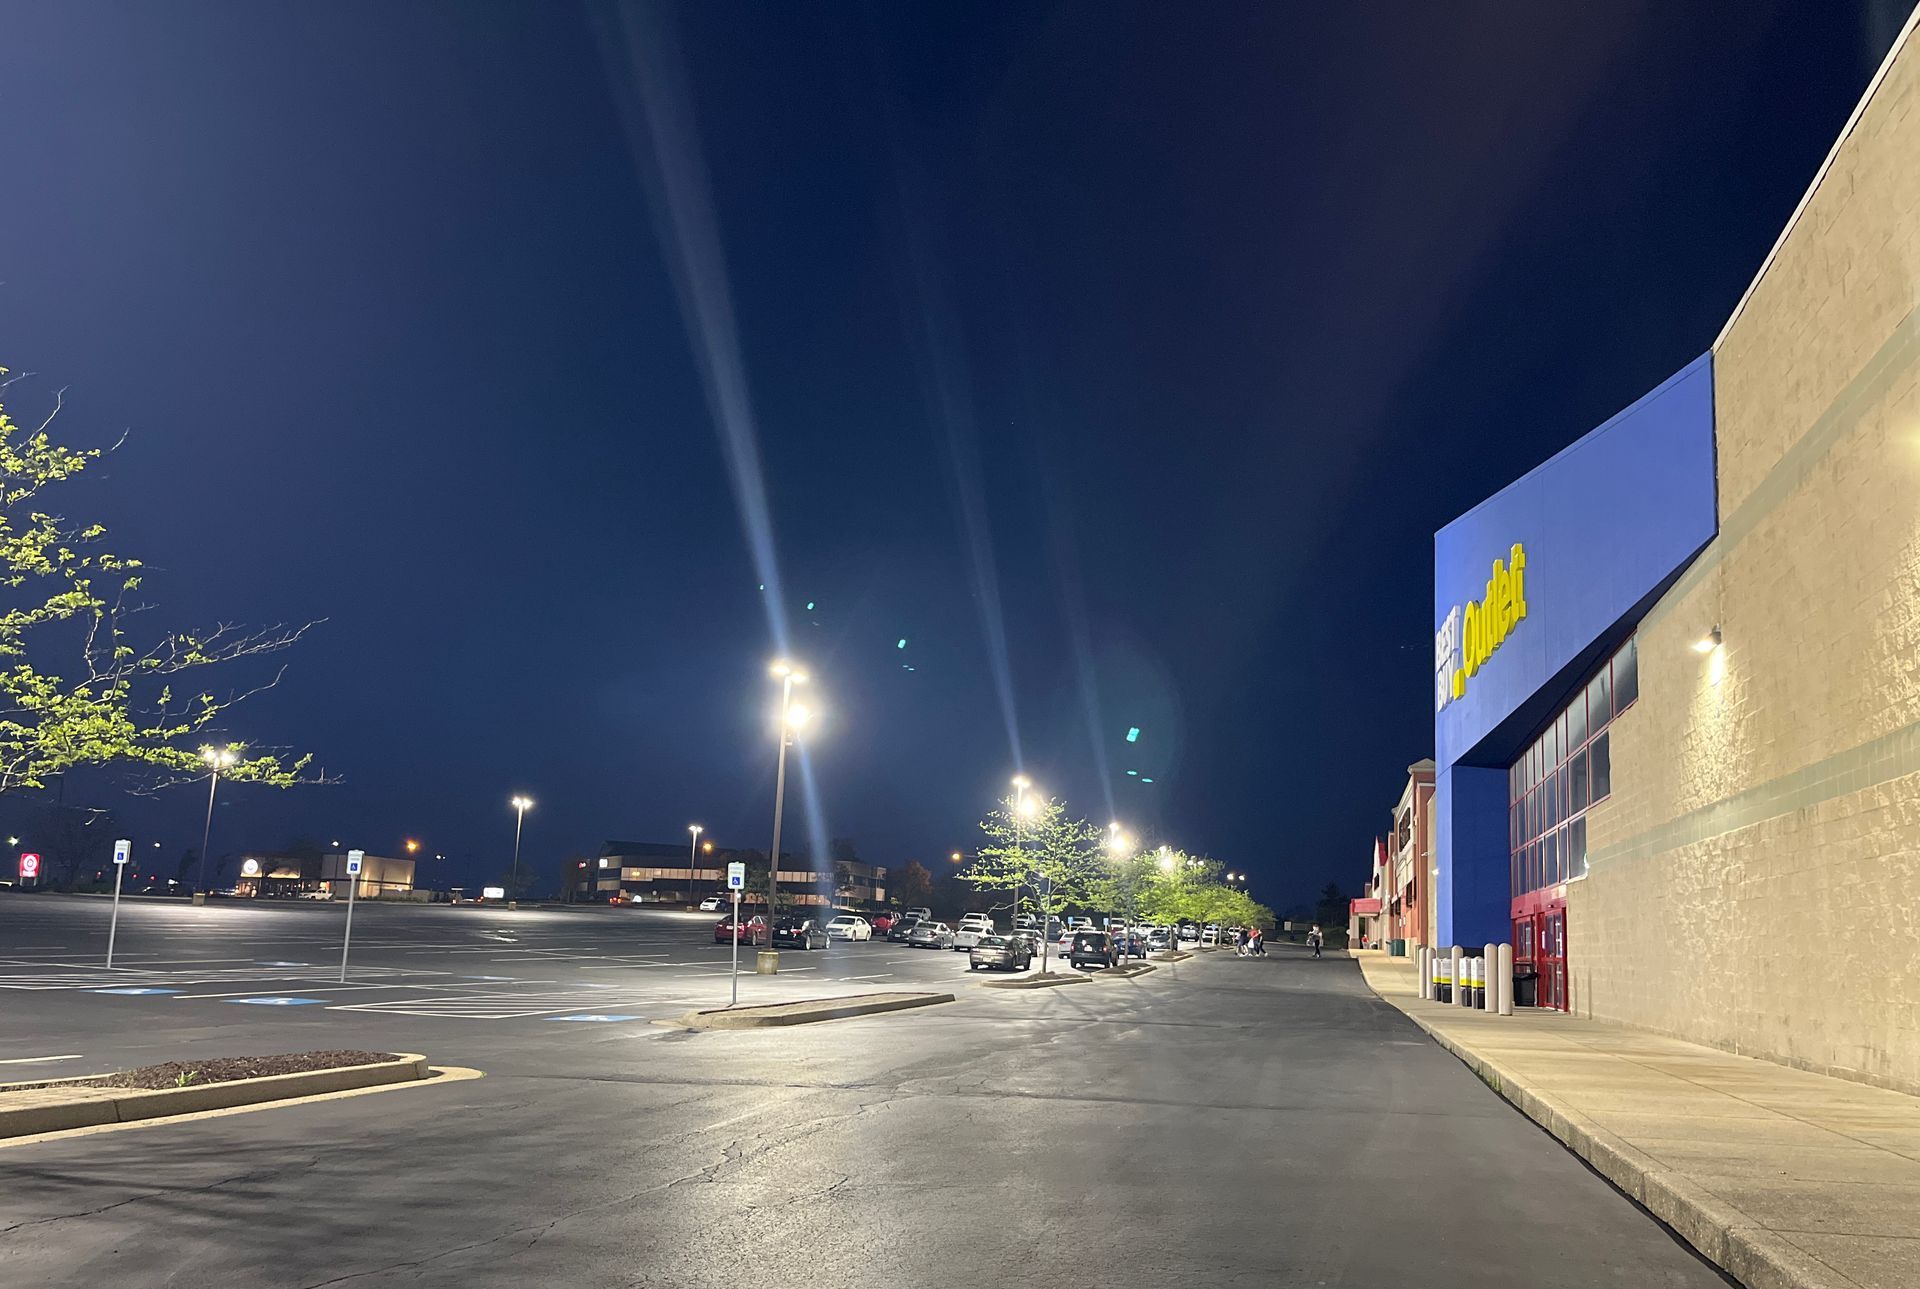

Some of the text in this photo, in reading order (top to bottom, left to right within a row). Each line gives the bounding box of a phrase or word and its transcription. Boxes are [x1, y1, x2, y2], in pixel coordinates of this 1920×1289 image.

[1436, 605, 1461, 672] BEST
[1462, 543, 1527, 678] Outlet
[1437, 651, 1460, 712] BUY
